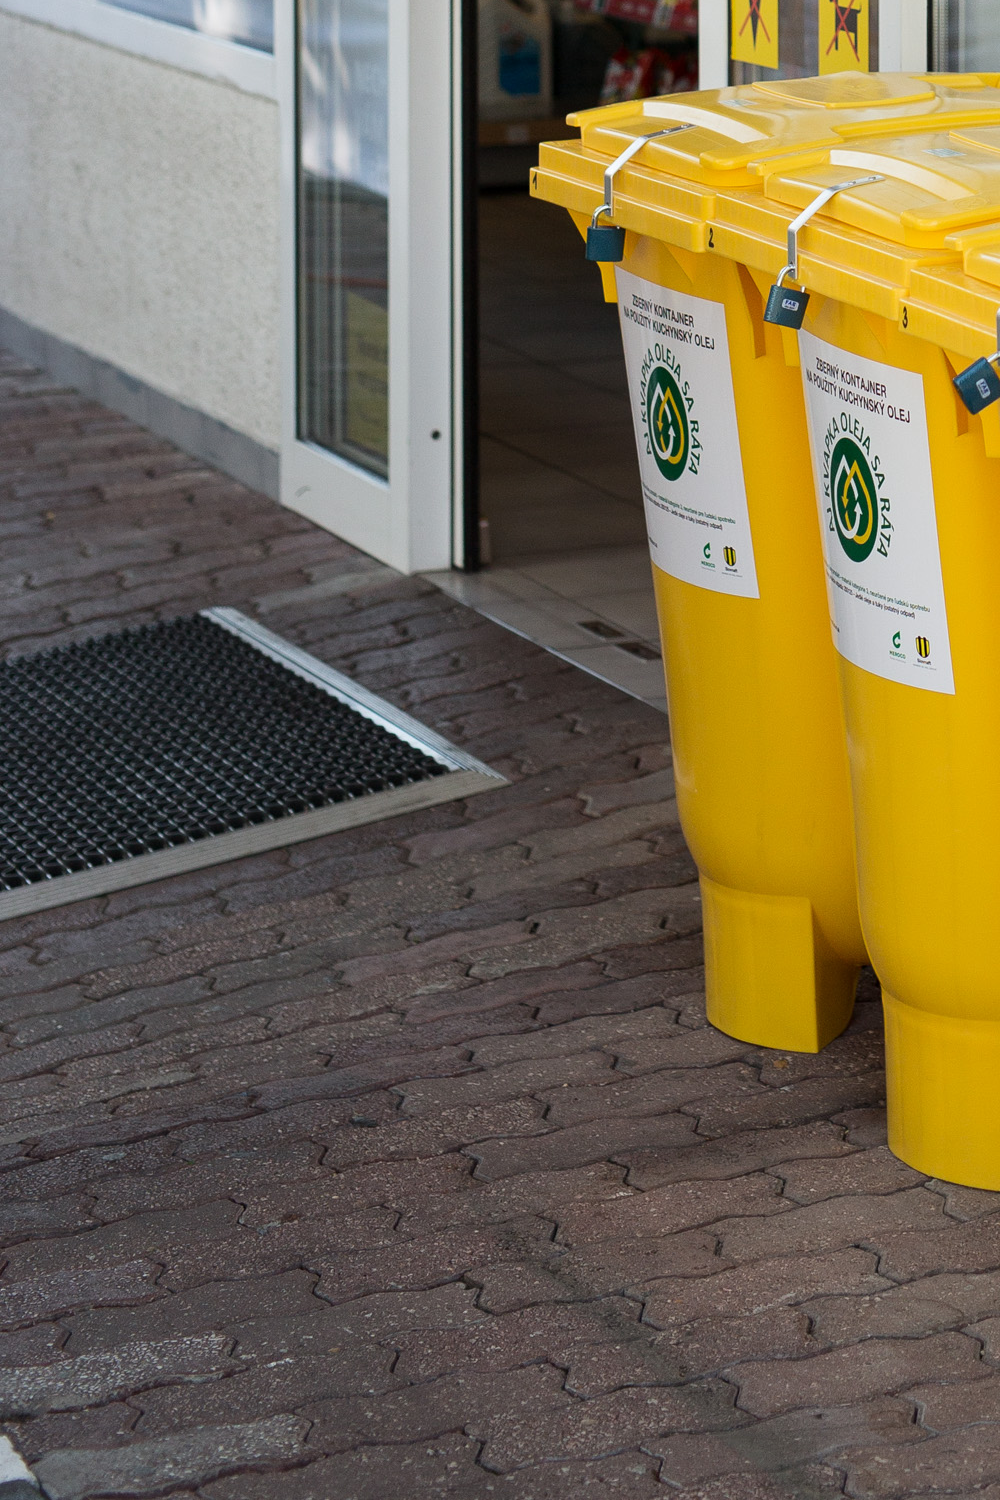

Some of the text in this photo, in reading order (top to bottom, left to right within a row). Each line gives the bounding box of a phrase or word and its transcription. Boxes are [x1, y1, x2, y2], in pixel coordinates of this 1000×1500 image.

[708, 227, 714, 248] 2
[624, 306, 630, 318] NA
[653, 320, 693, 344] KUCHYNSKÝ
[694, 334, 715, 350] OLEJ
[632, 294, 694, 328] ZBERNÝ KONTAJNER
[902, 306, 909, 329] 3
[806, 368, 911, 423] NA POUŽITÝ KUCHYNSKÝ OLEJ
[816, 357, 887, 398] ZBERNÝ KONTAJNER
[640, 348, 655, 423] KVAPKA
[654, 343, 682, 382] OLEJA
[682, 381, 695, 413] SA
[689, 420, 703, 475] RÁTA
[840, 412, 871, 456] OLEJA
[824, 417, 840, 498] KVAPKA
[871, 455, 886, 490] SA
[877, 498, 895, 558] RÁTA
[910, 604, 931, 613] spotrebu
